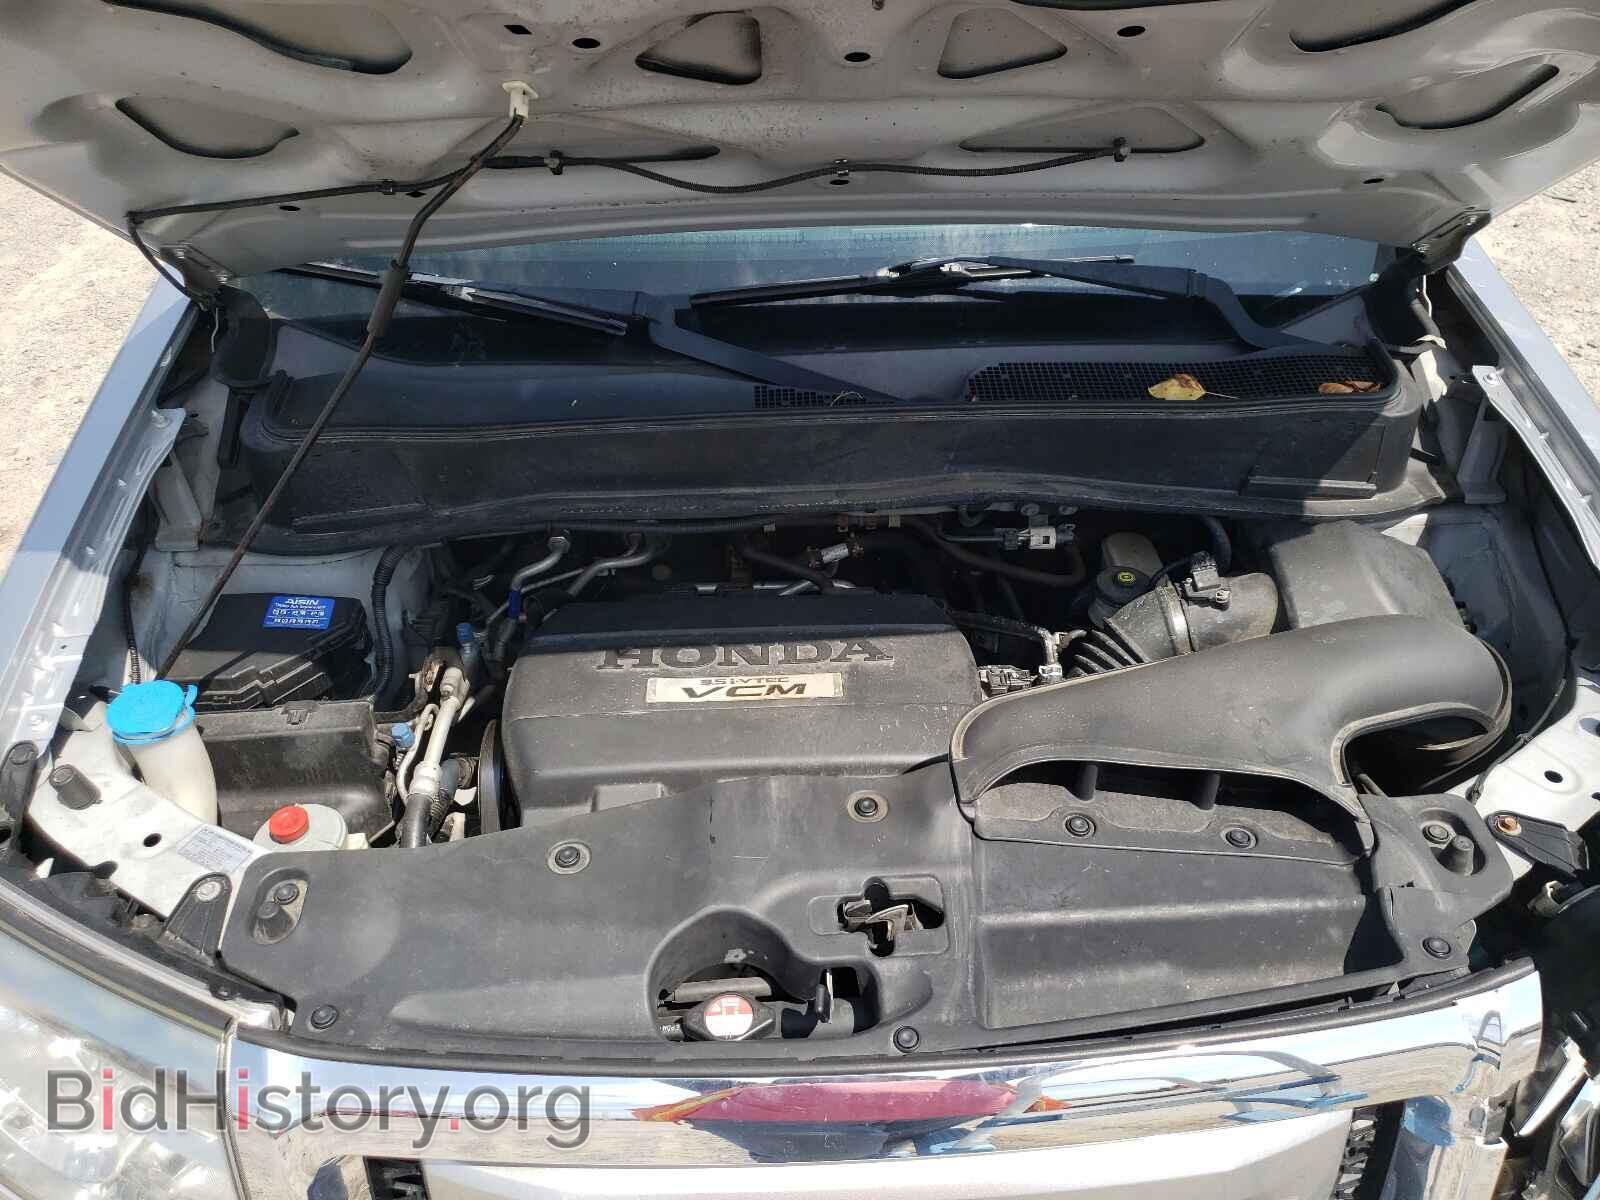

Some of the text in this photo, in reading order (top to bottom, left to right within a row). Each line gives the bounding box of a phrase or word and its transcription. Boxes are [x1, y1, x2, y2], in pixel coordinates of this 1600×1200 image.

[285, 598, 319, 606] AISIN
[596, 639, 895, 670] HONDA
[681, 682, 808, 699] VCM
